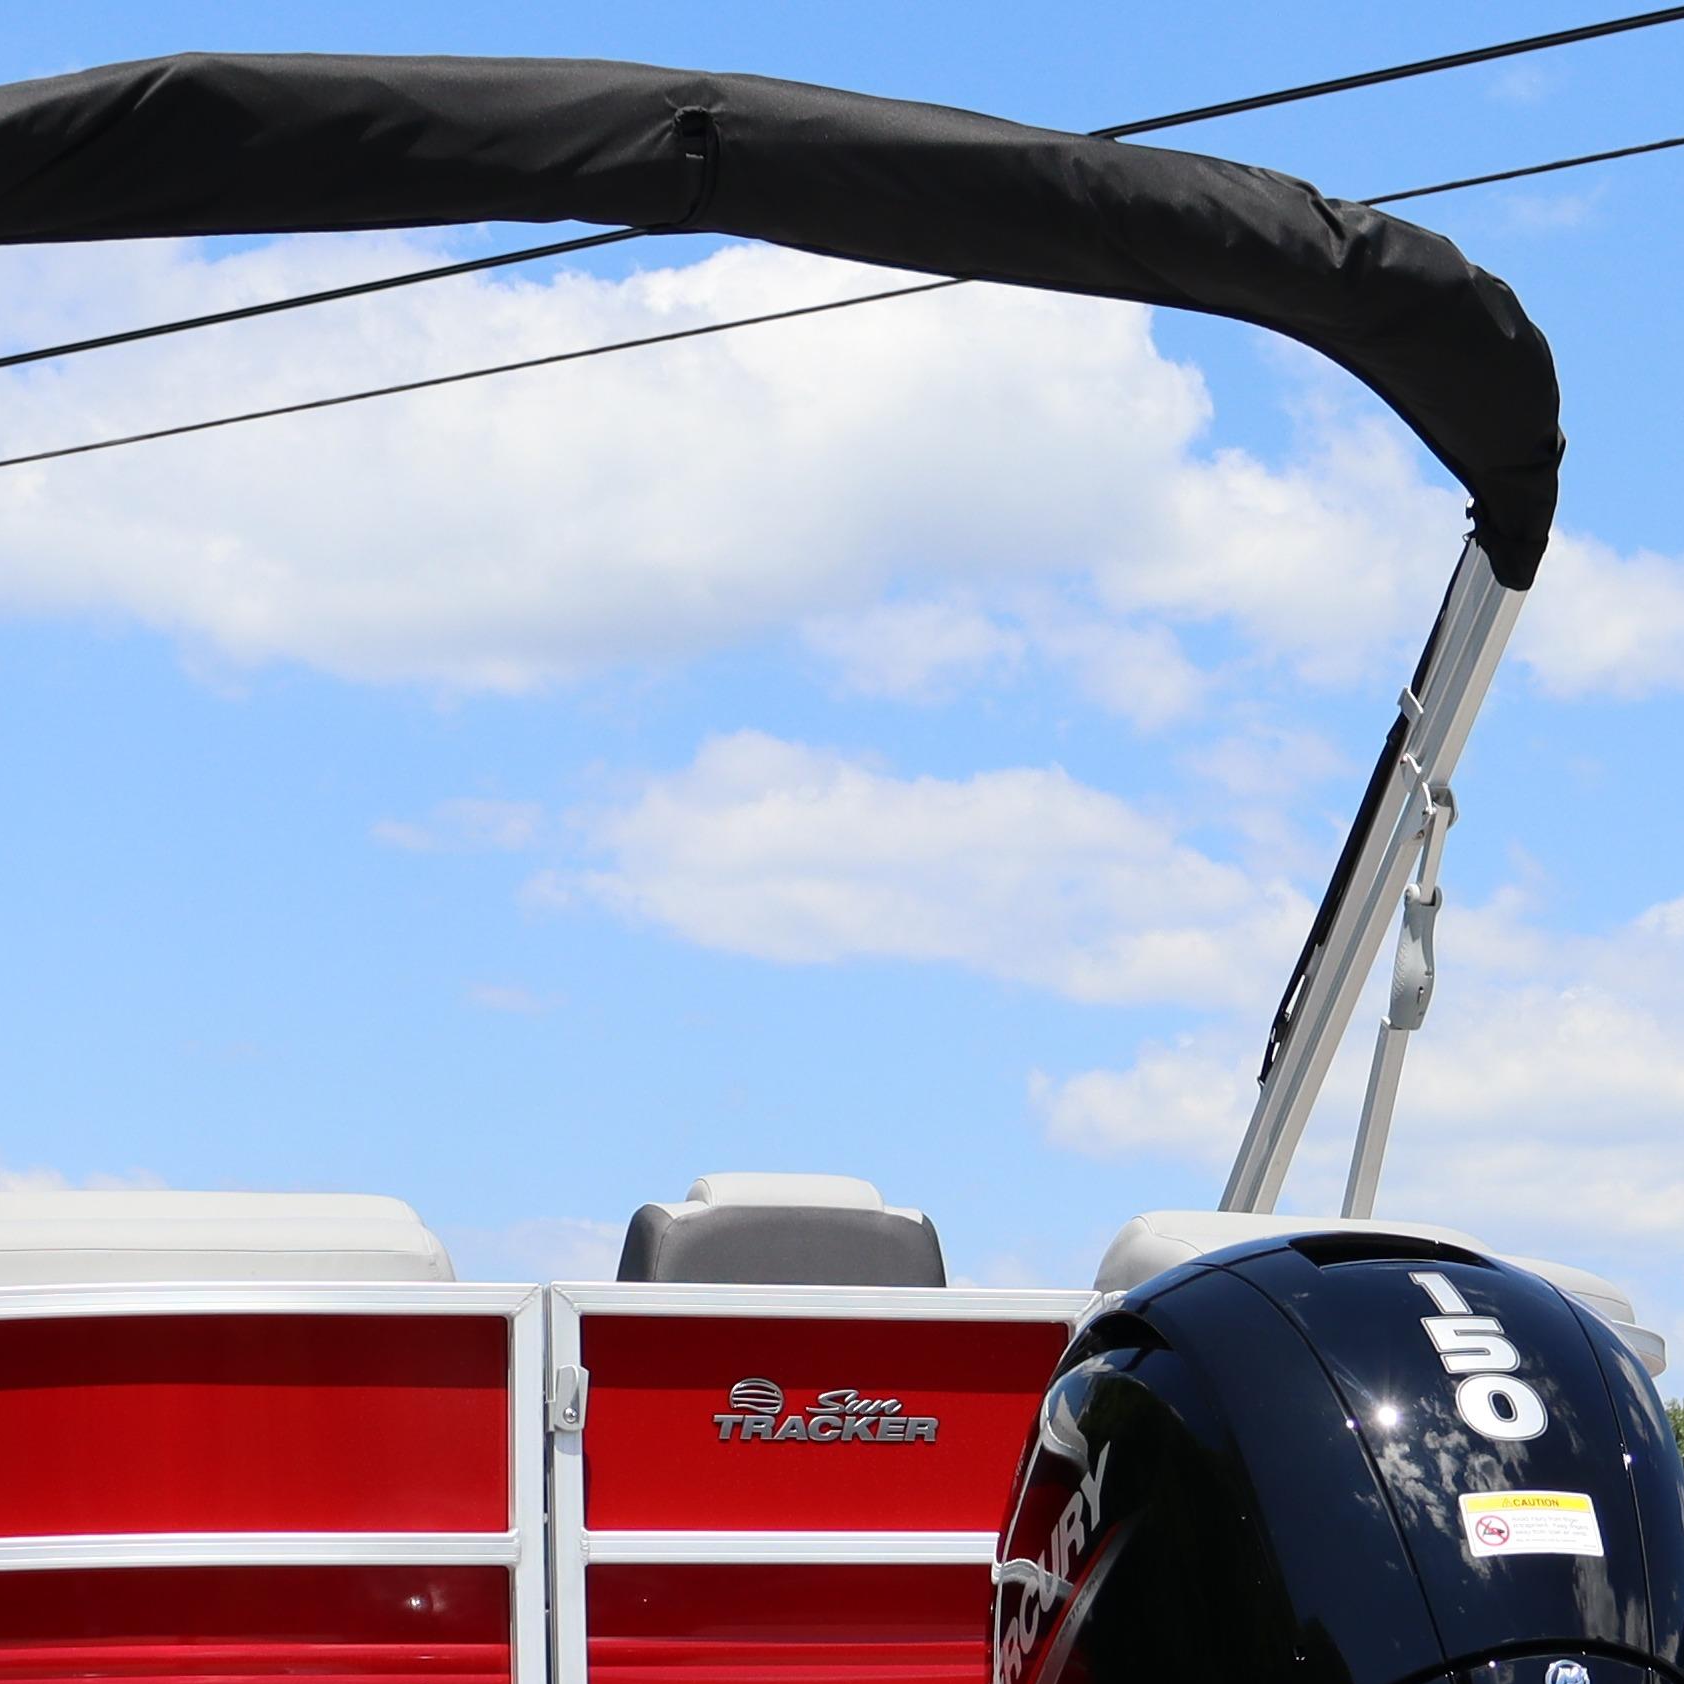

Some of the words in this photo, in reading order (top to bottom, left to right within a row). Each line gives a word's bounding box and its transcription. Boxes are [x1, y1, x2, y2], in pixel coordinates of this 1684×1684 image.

[1408, 1271, 1549, 1441] 150
[806, 1389, 903, 1415] Sun
[713, 1414, 938, 1442] TRACKER
[1513, 1498, 1559, 1507] CAUTION
